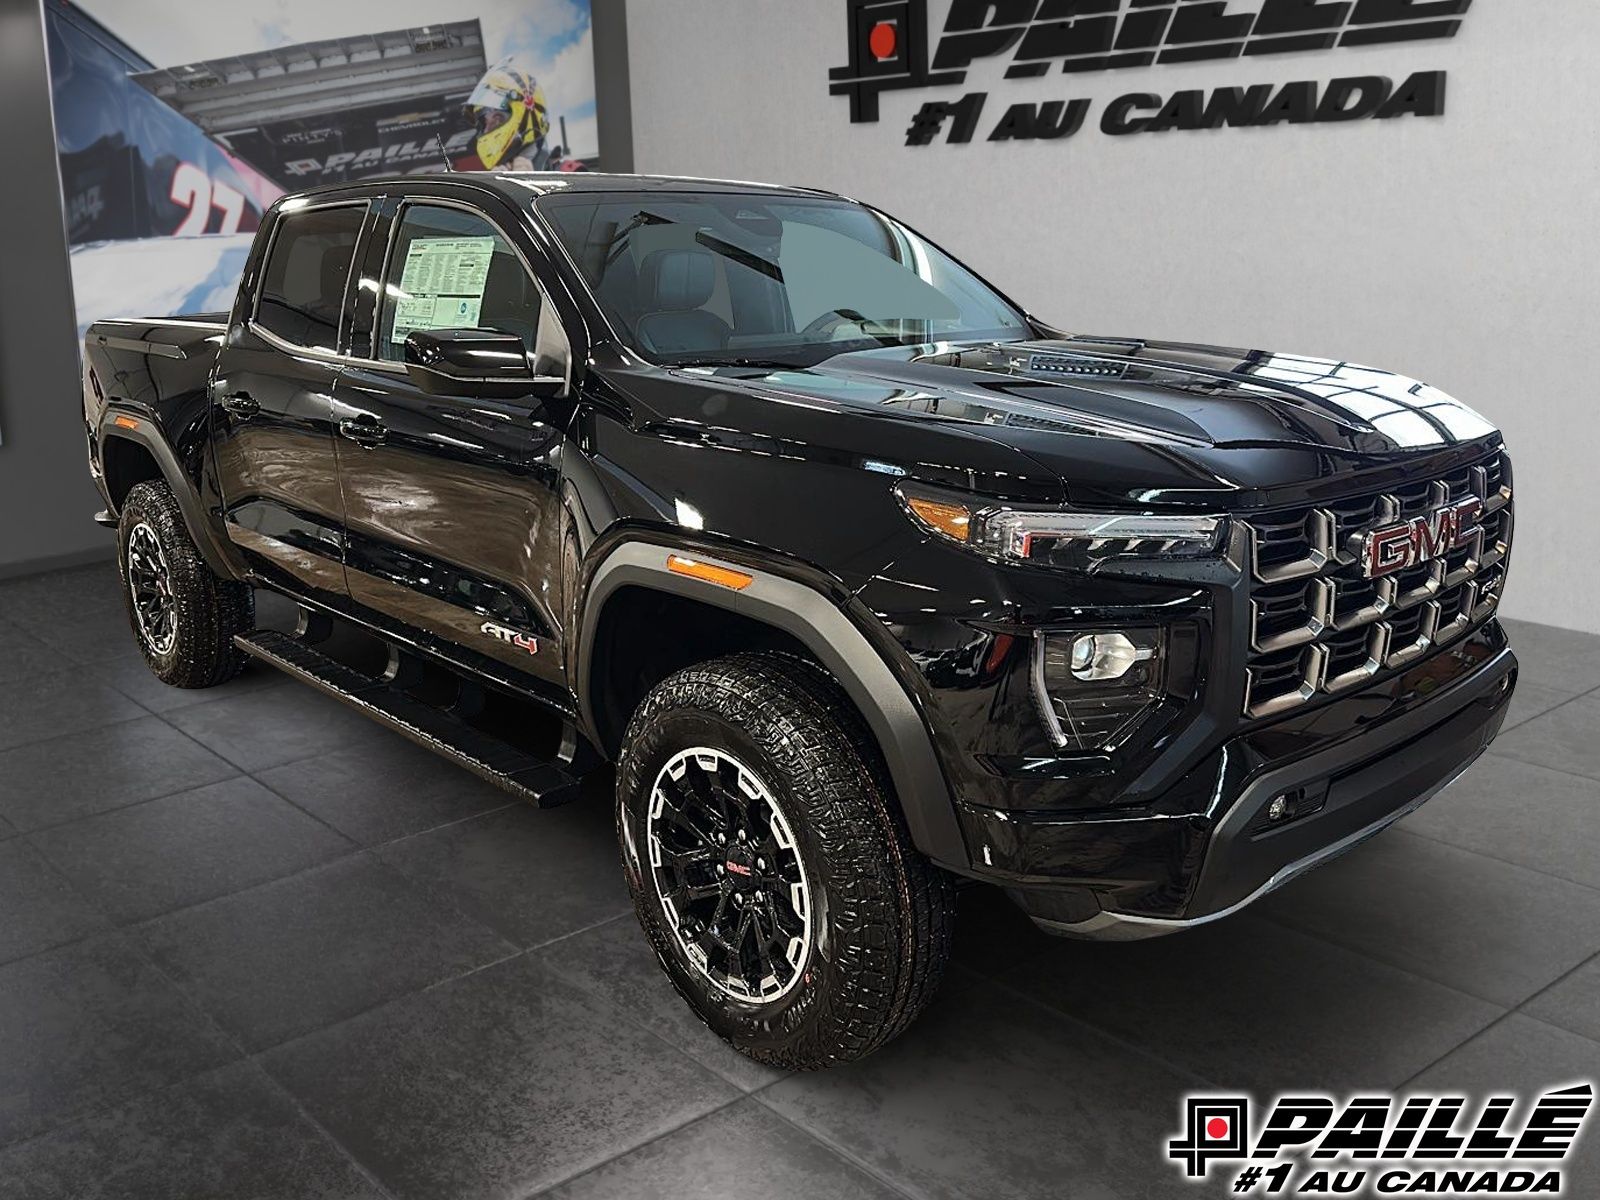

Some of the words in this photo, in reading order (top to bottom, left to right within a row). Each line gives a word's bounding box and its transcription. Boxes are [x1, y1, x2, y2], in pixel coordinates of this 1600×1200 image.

[904, 91, 988, 147] #1
[987, 98, 1092, 142] AU
[1100, 70, 1447, 136] CANADA
[170, 160, 246, 237] 27
[1362, 494, 1483, 580] GMC
[480, 621, 539, 655] AT4
